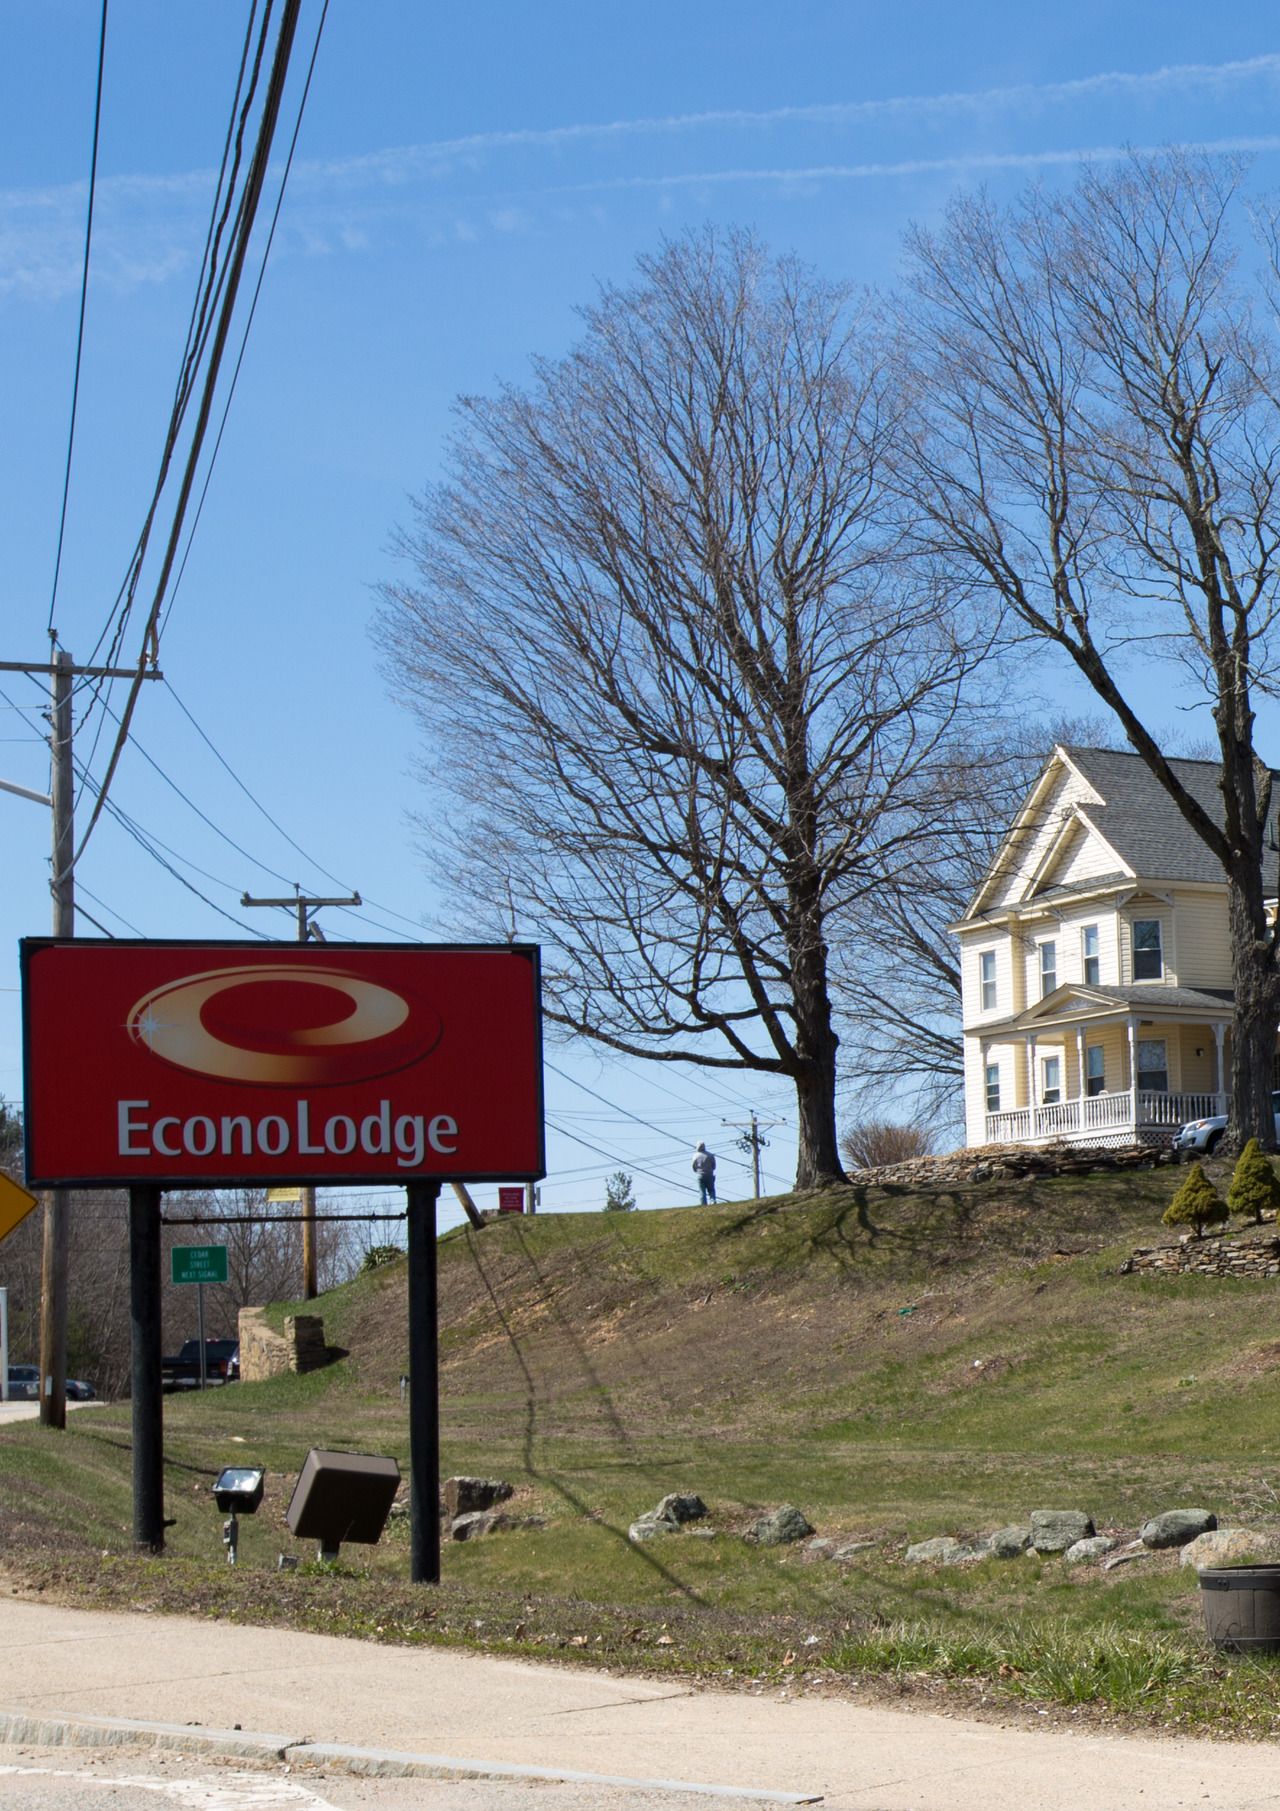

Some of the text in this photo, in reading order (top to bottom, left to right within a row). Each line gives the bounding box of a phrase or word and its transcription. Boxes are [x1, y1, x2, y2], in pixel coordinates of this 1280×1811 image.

[117, 1099, 458, 1167] EconoLodge
[190, 1250, 209, 1259] CEDAR
[190, 1260, 210, 1269] STREET
[181, 1270, 218, 1279] NEXT SIGNAL
